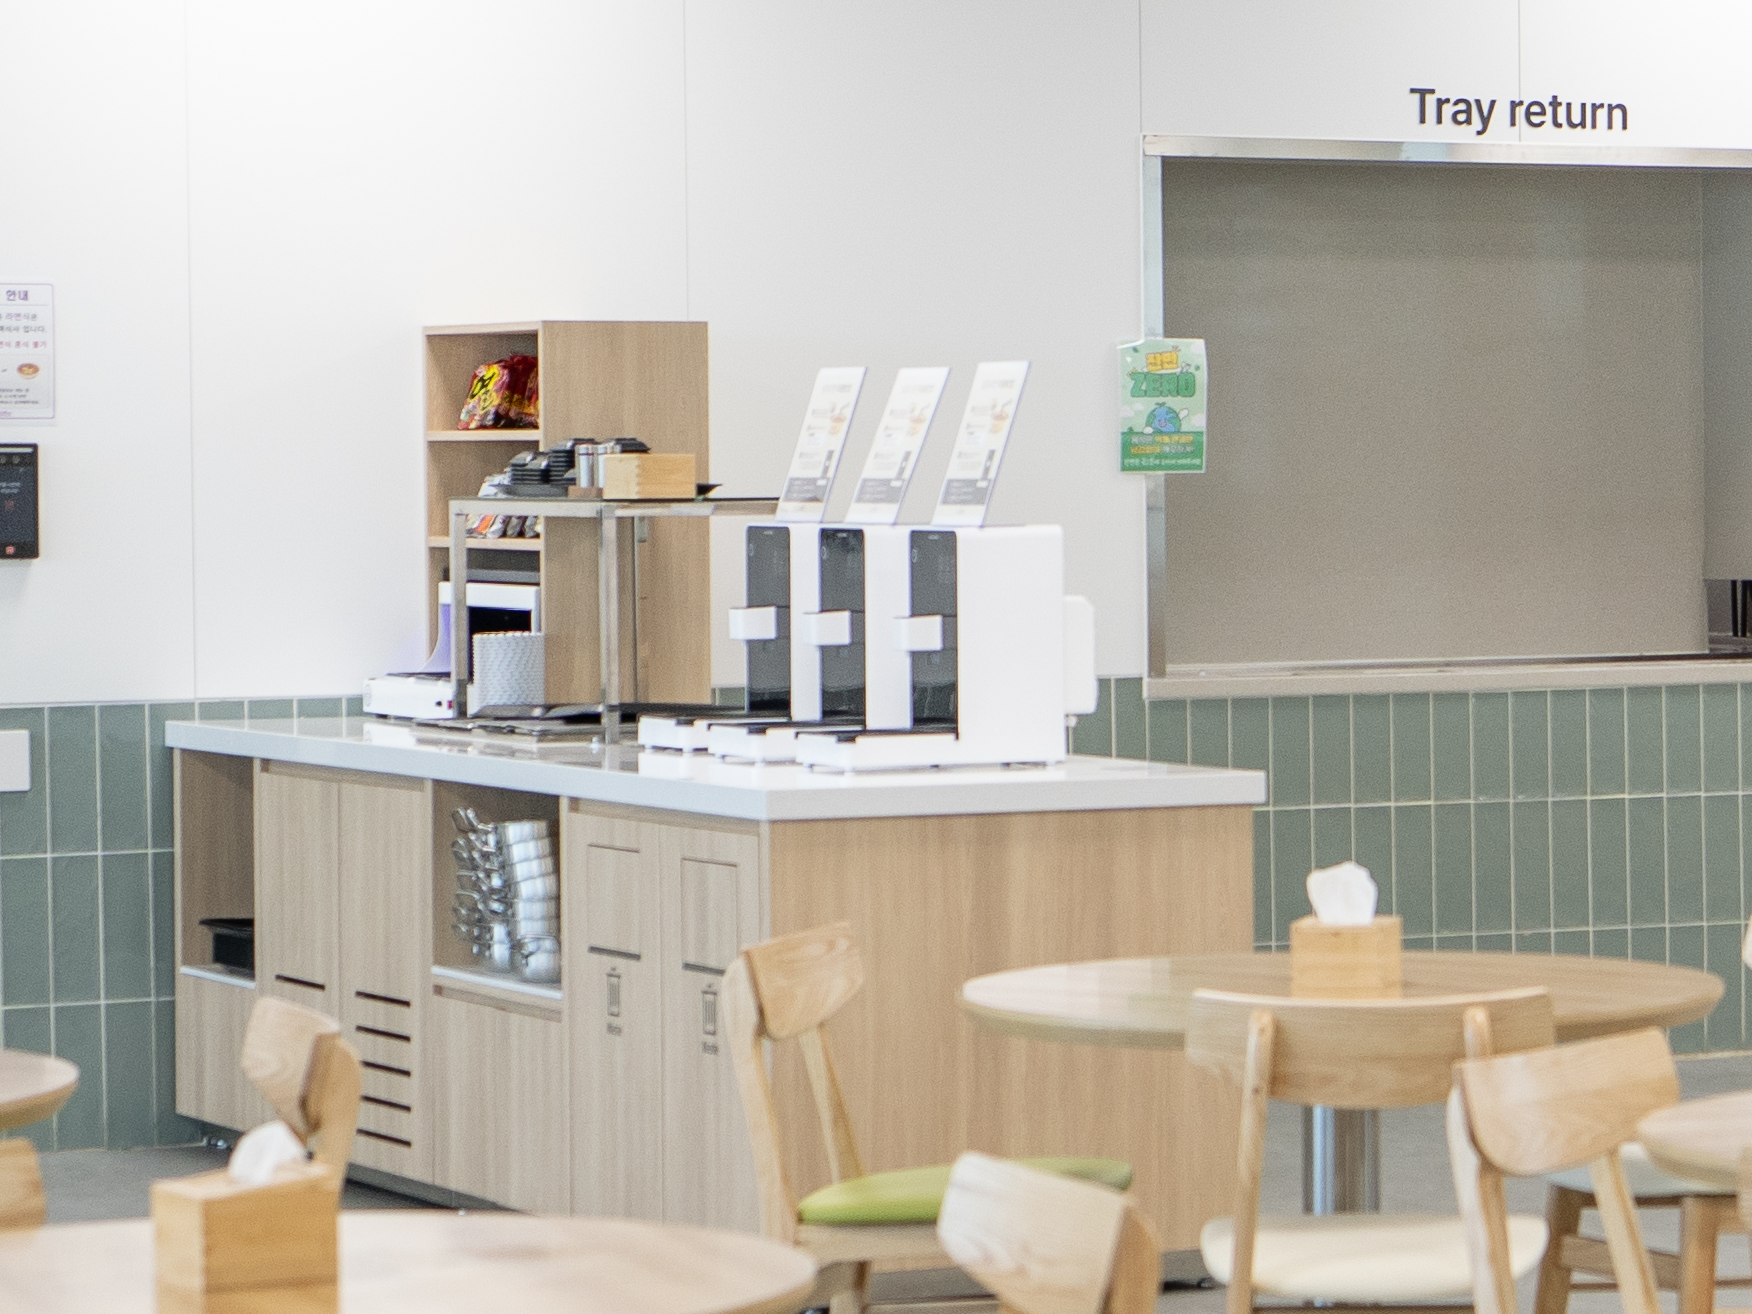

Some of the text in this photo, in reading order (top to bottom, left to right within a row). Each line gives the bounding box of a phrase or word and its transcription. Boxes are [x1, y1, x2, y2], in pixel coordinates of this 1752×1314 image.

[1409, 87, 1628, 136] Tray return
[6, 289, 29, 301] 안내
[1130, 371, 1197, 398] ZERO
